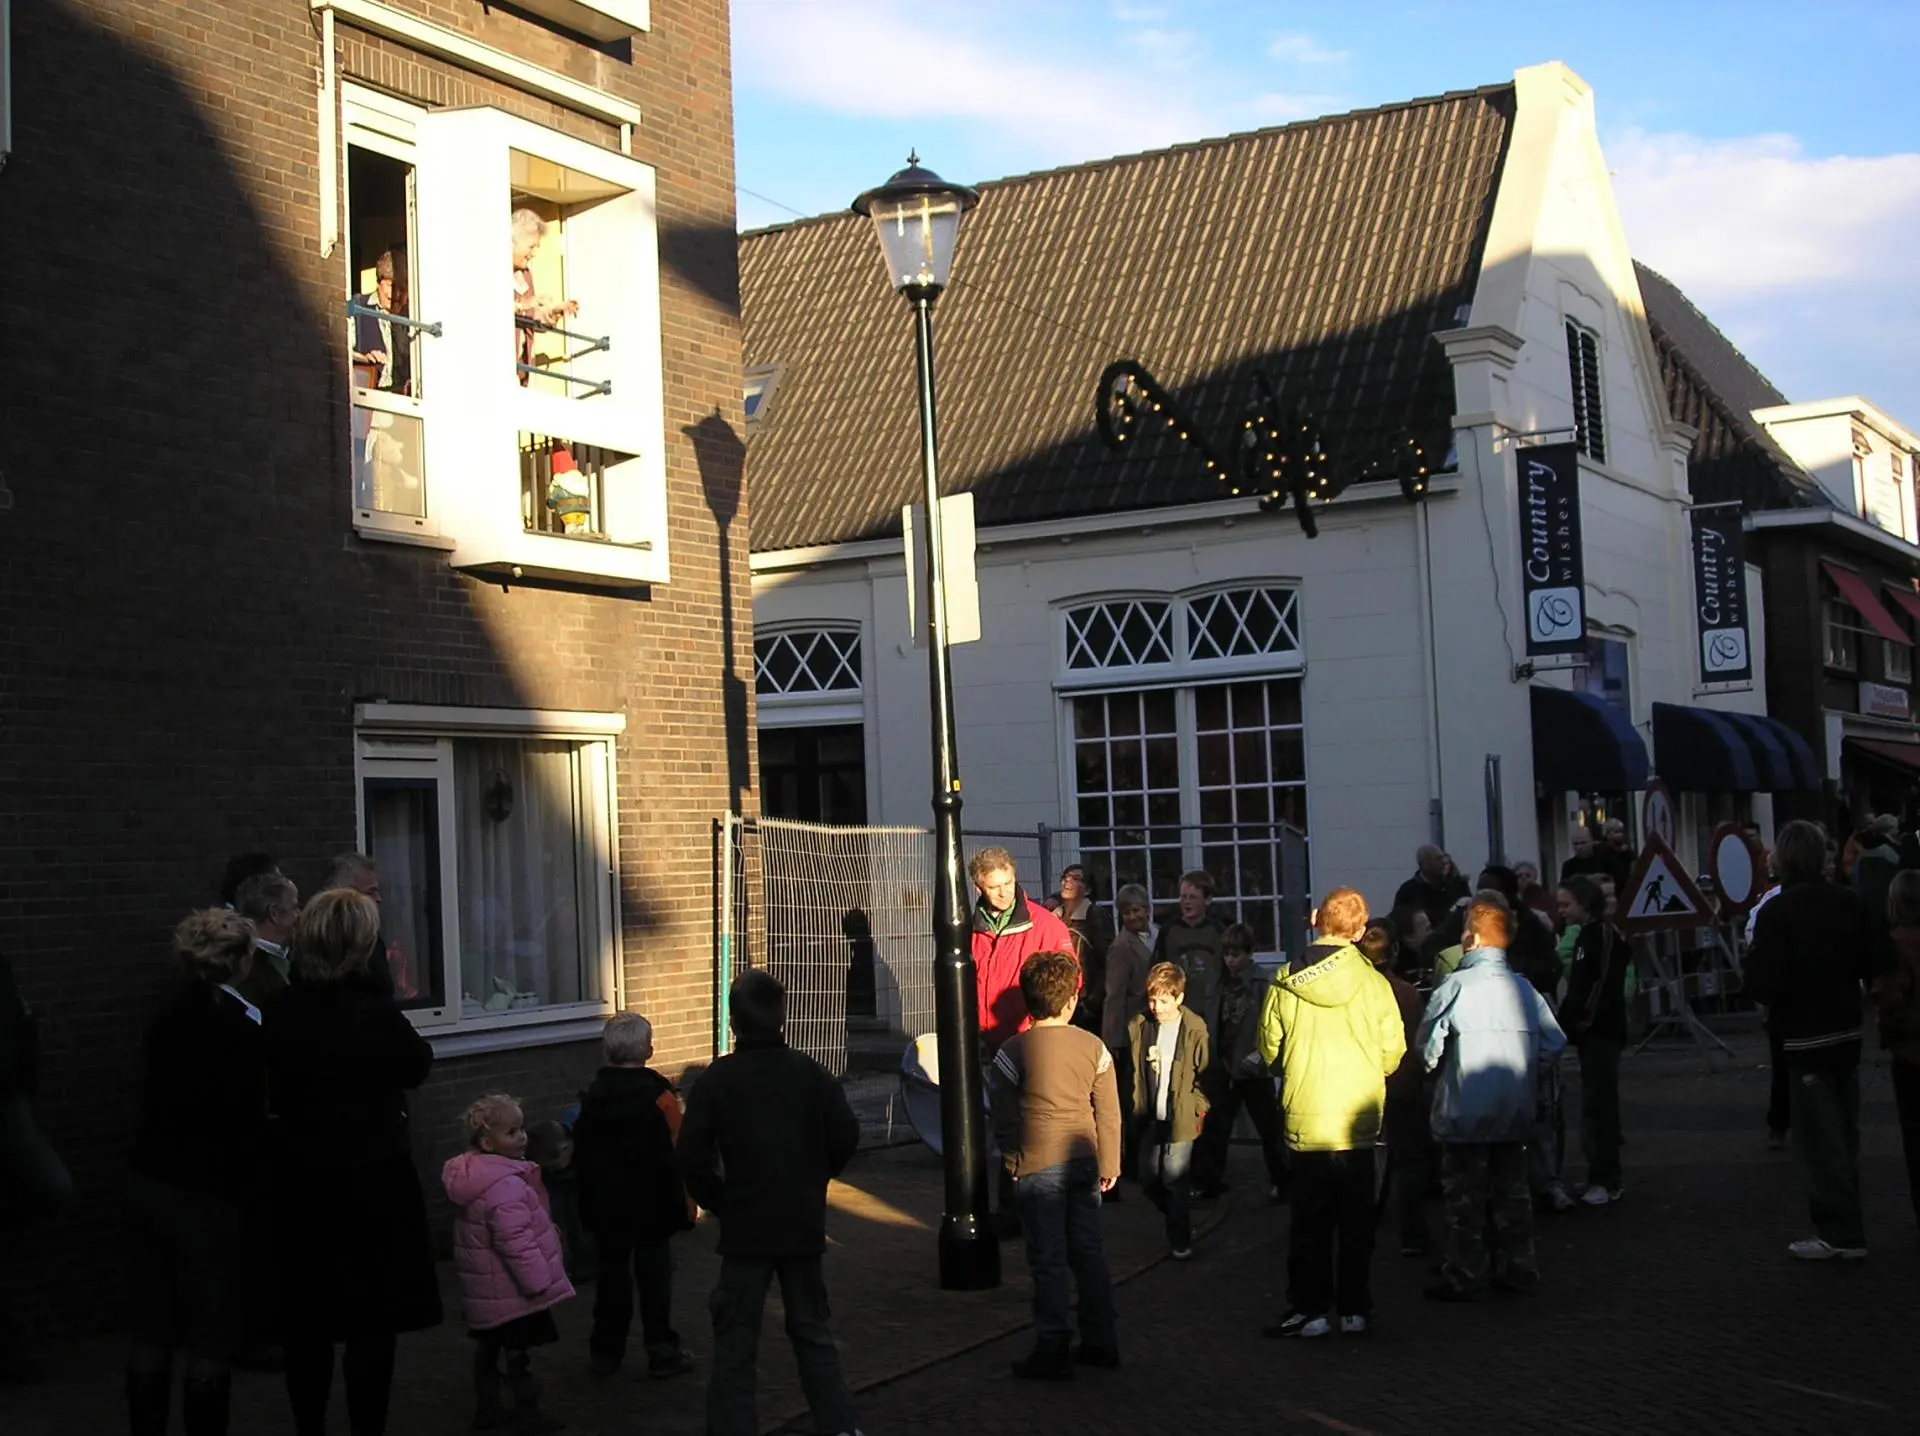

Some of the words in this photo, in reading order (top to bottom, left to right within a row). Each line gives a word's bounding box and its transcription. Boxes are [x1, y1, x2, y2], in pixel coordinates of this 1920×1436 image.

[1528, 460, 1556, 583] Country
[1558, 497, 1573, 581] wishes
[1701, 527, 1725, 625] Country
[1726, 556, 1738, 623] wishes
[1291, 960, 1337, 988] POINTER
